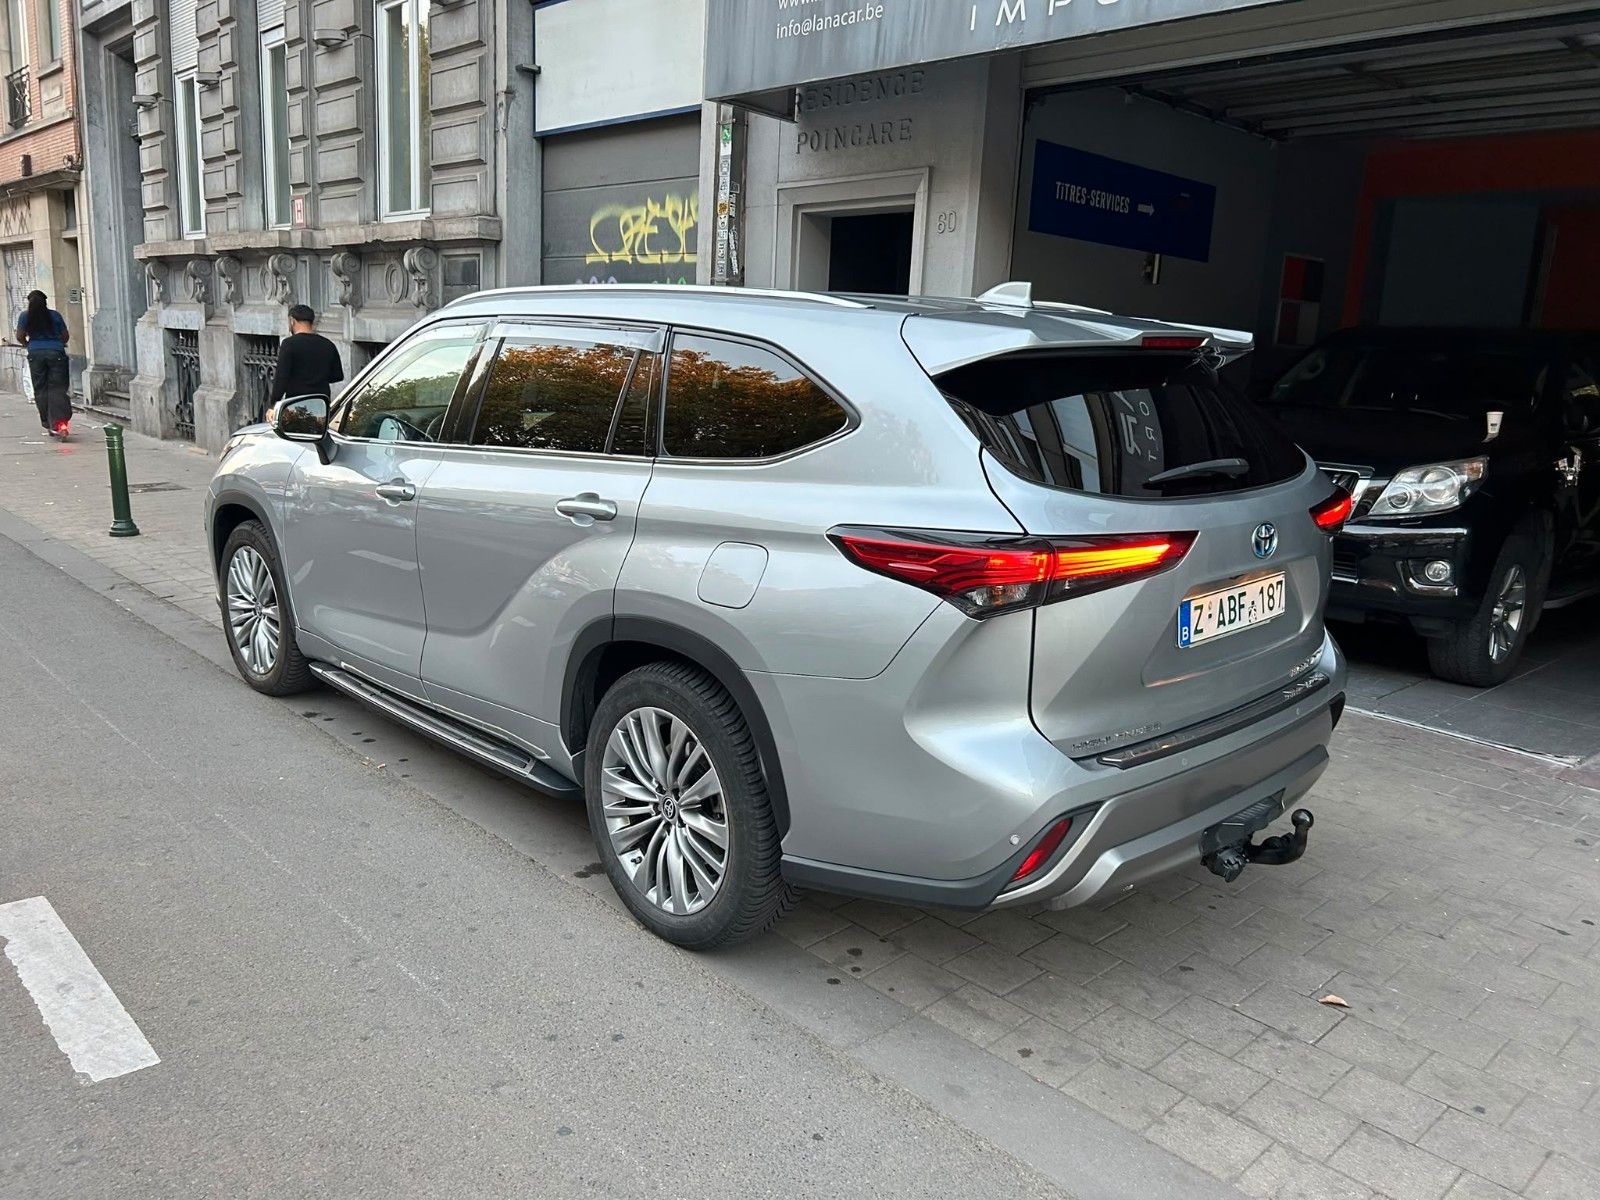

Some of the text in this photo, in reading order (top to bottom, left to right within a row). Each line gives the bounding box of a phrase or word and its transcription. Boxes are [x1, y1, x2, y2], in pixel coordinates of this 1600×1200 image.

[776, 3, 884, 39] info@lanacar.be
[970, 0, 1121, 31] IMP
[936, 209, 957, 234] 60
[1181, 626, 1190, 641] B
